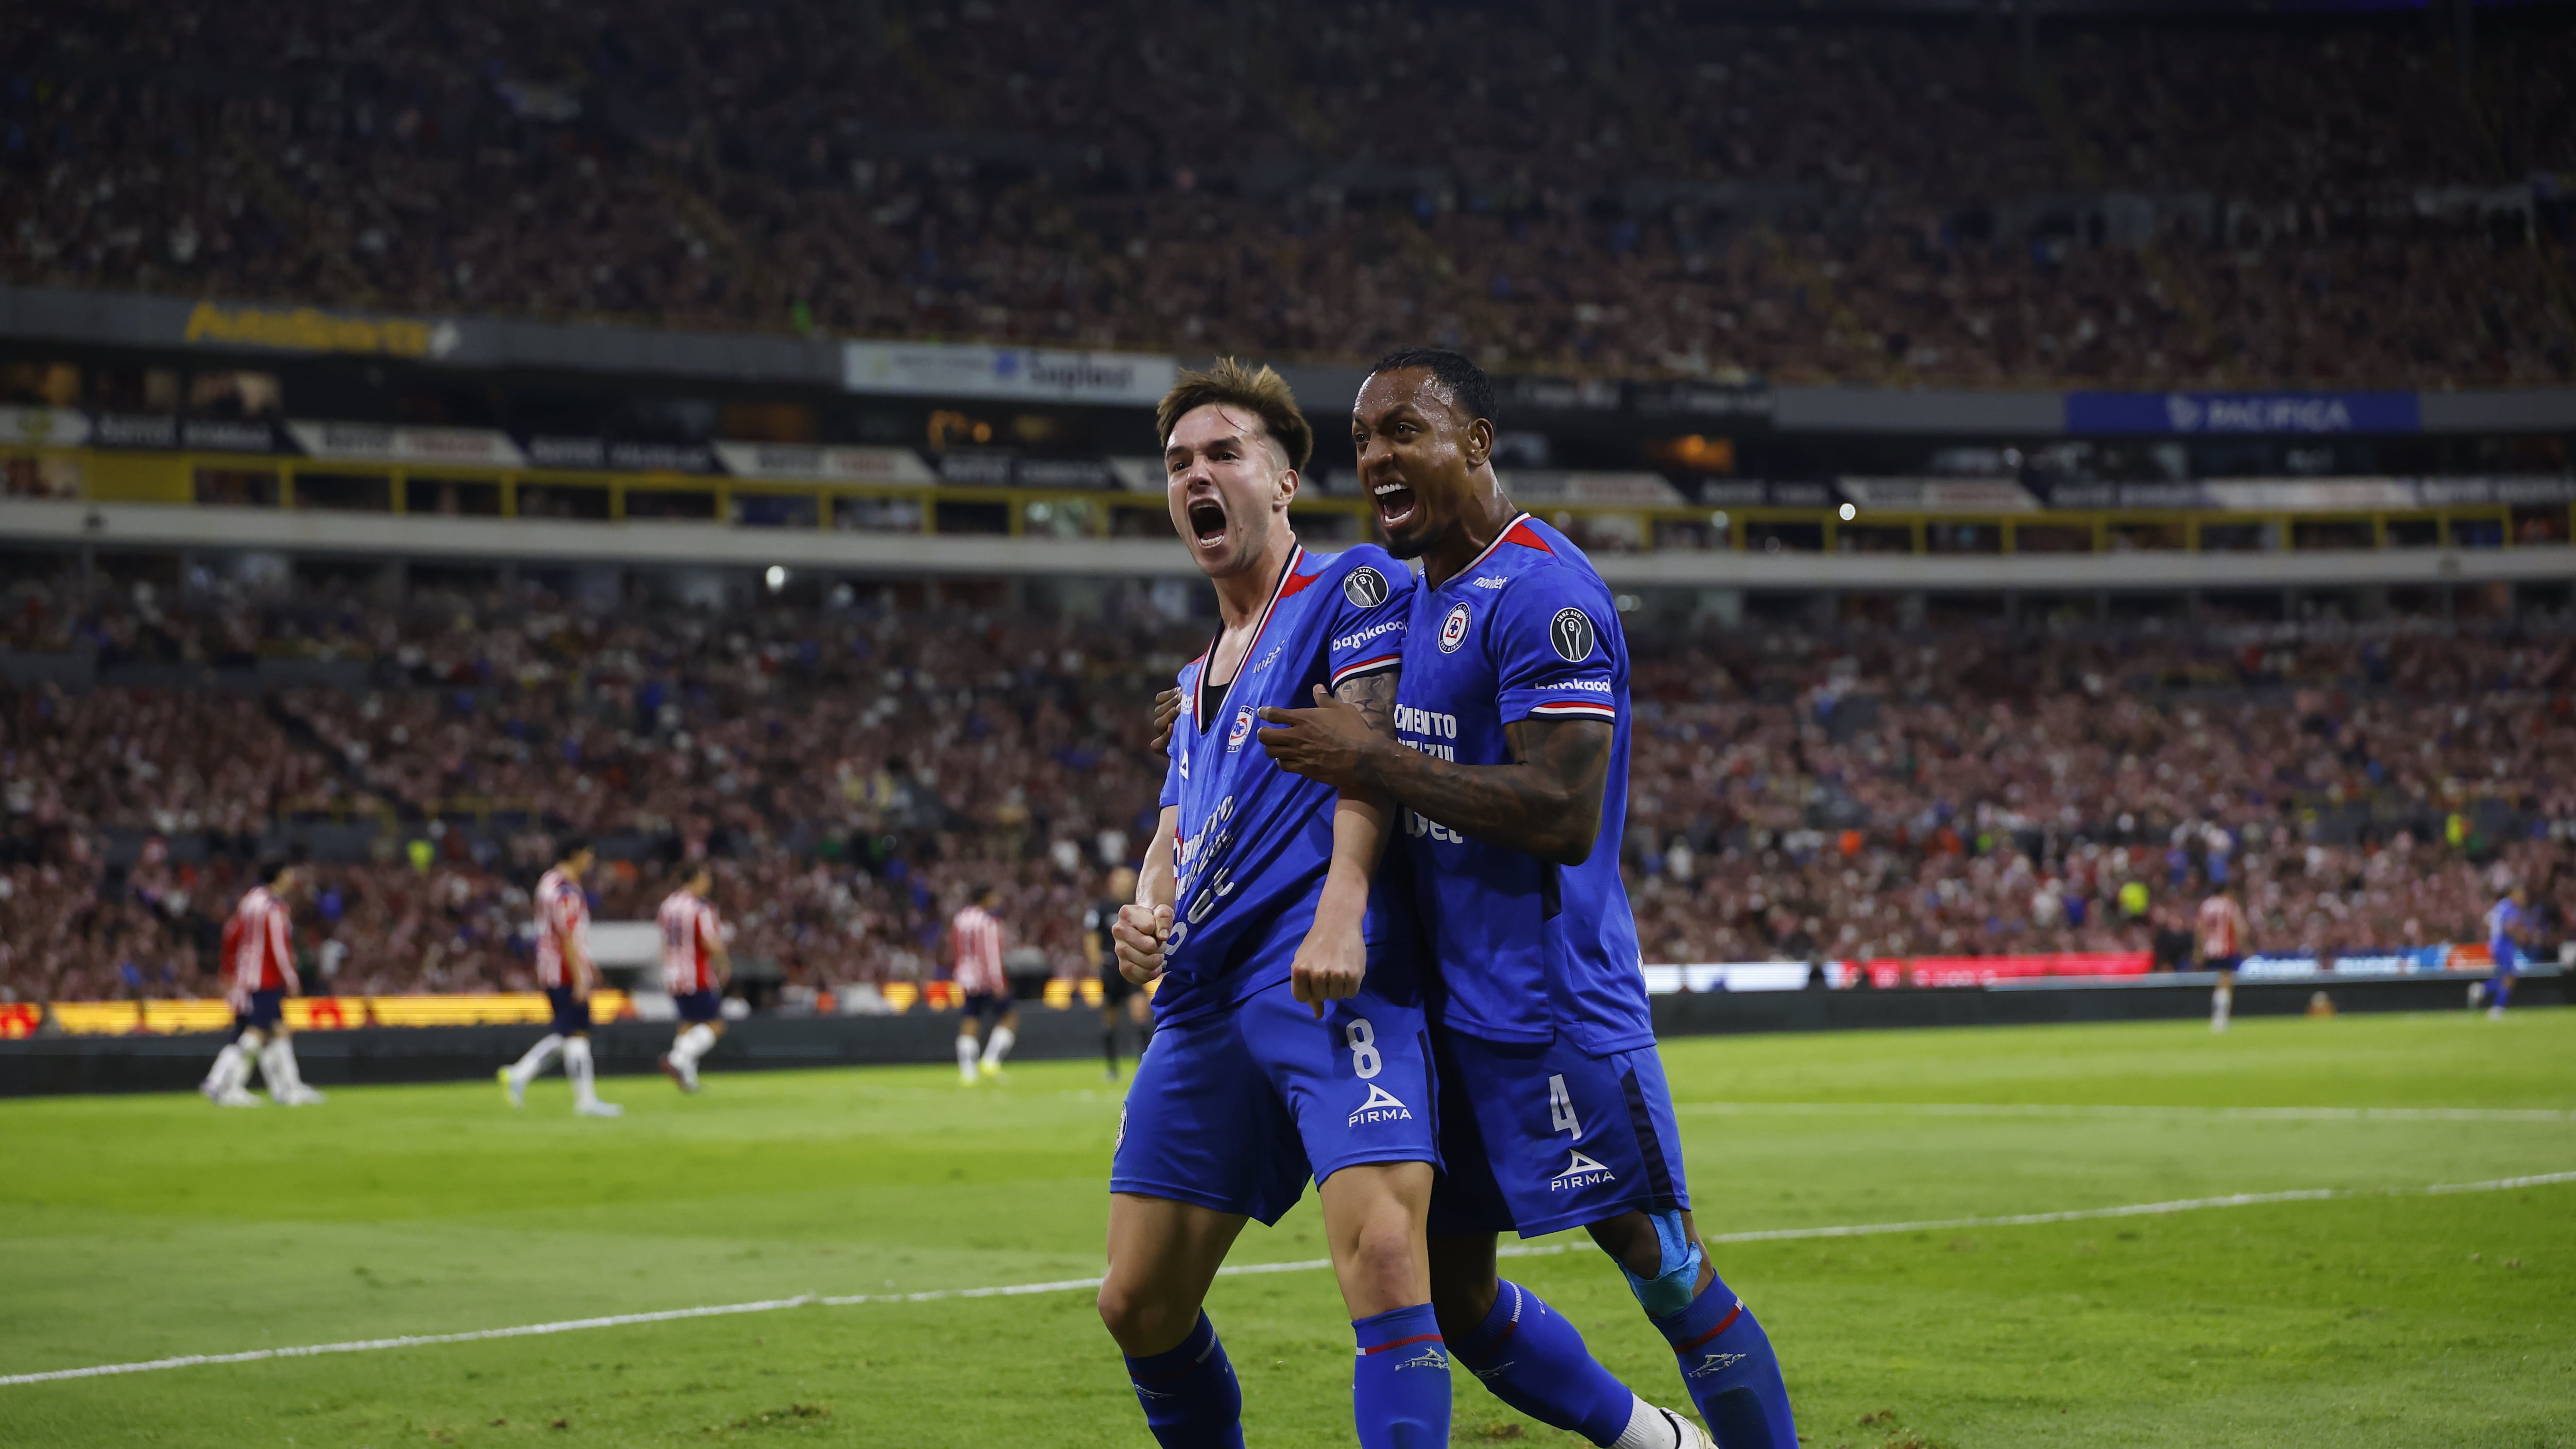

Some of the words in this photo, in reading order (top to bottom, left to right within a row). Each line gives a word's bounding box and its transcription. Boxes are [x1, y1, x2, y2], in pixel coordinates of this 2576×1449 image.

[1359, 576, 1367, 584] 9
[1557, 611, 1569, 622] CRUZ
[1570, 611, 1583, 620] AZUL
[1568, 621, 1574, 632] 9
[1346, 1018, 1382, 1079] 8
[1549, 1074, 1582, 1141] 4
[1348, 1109, 1413, 1128] PIRMA
[1551, 1170, 1616, 1191] PIRMA
